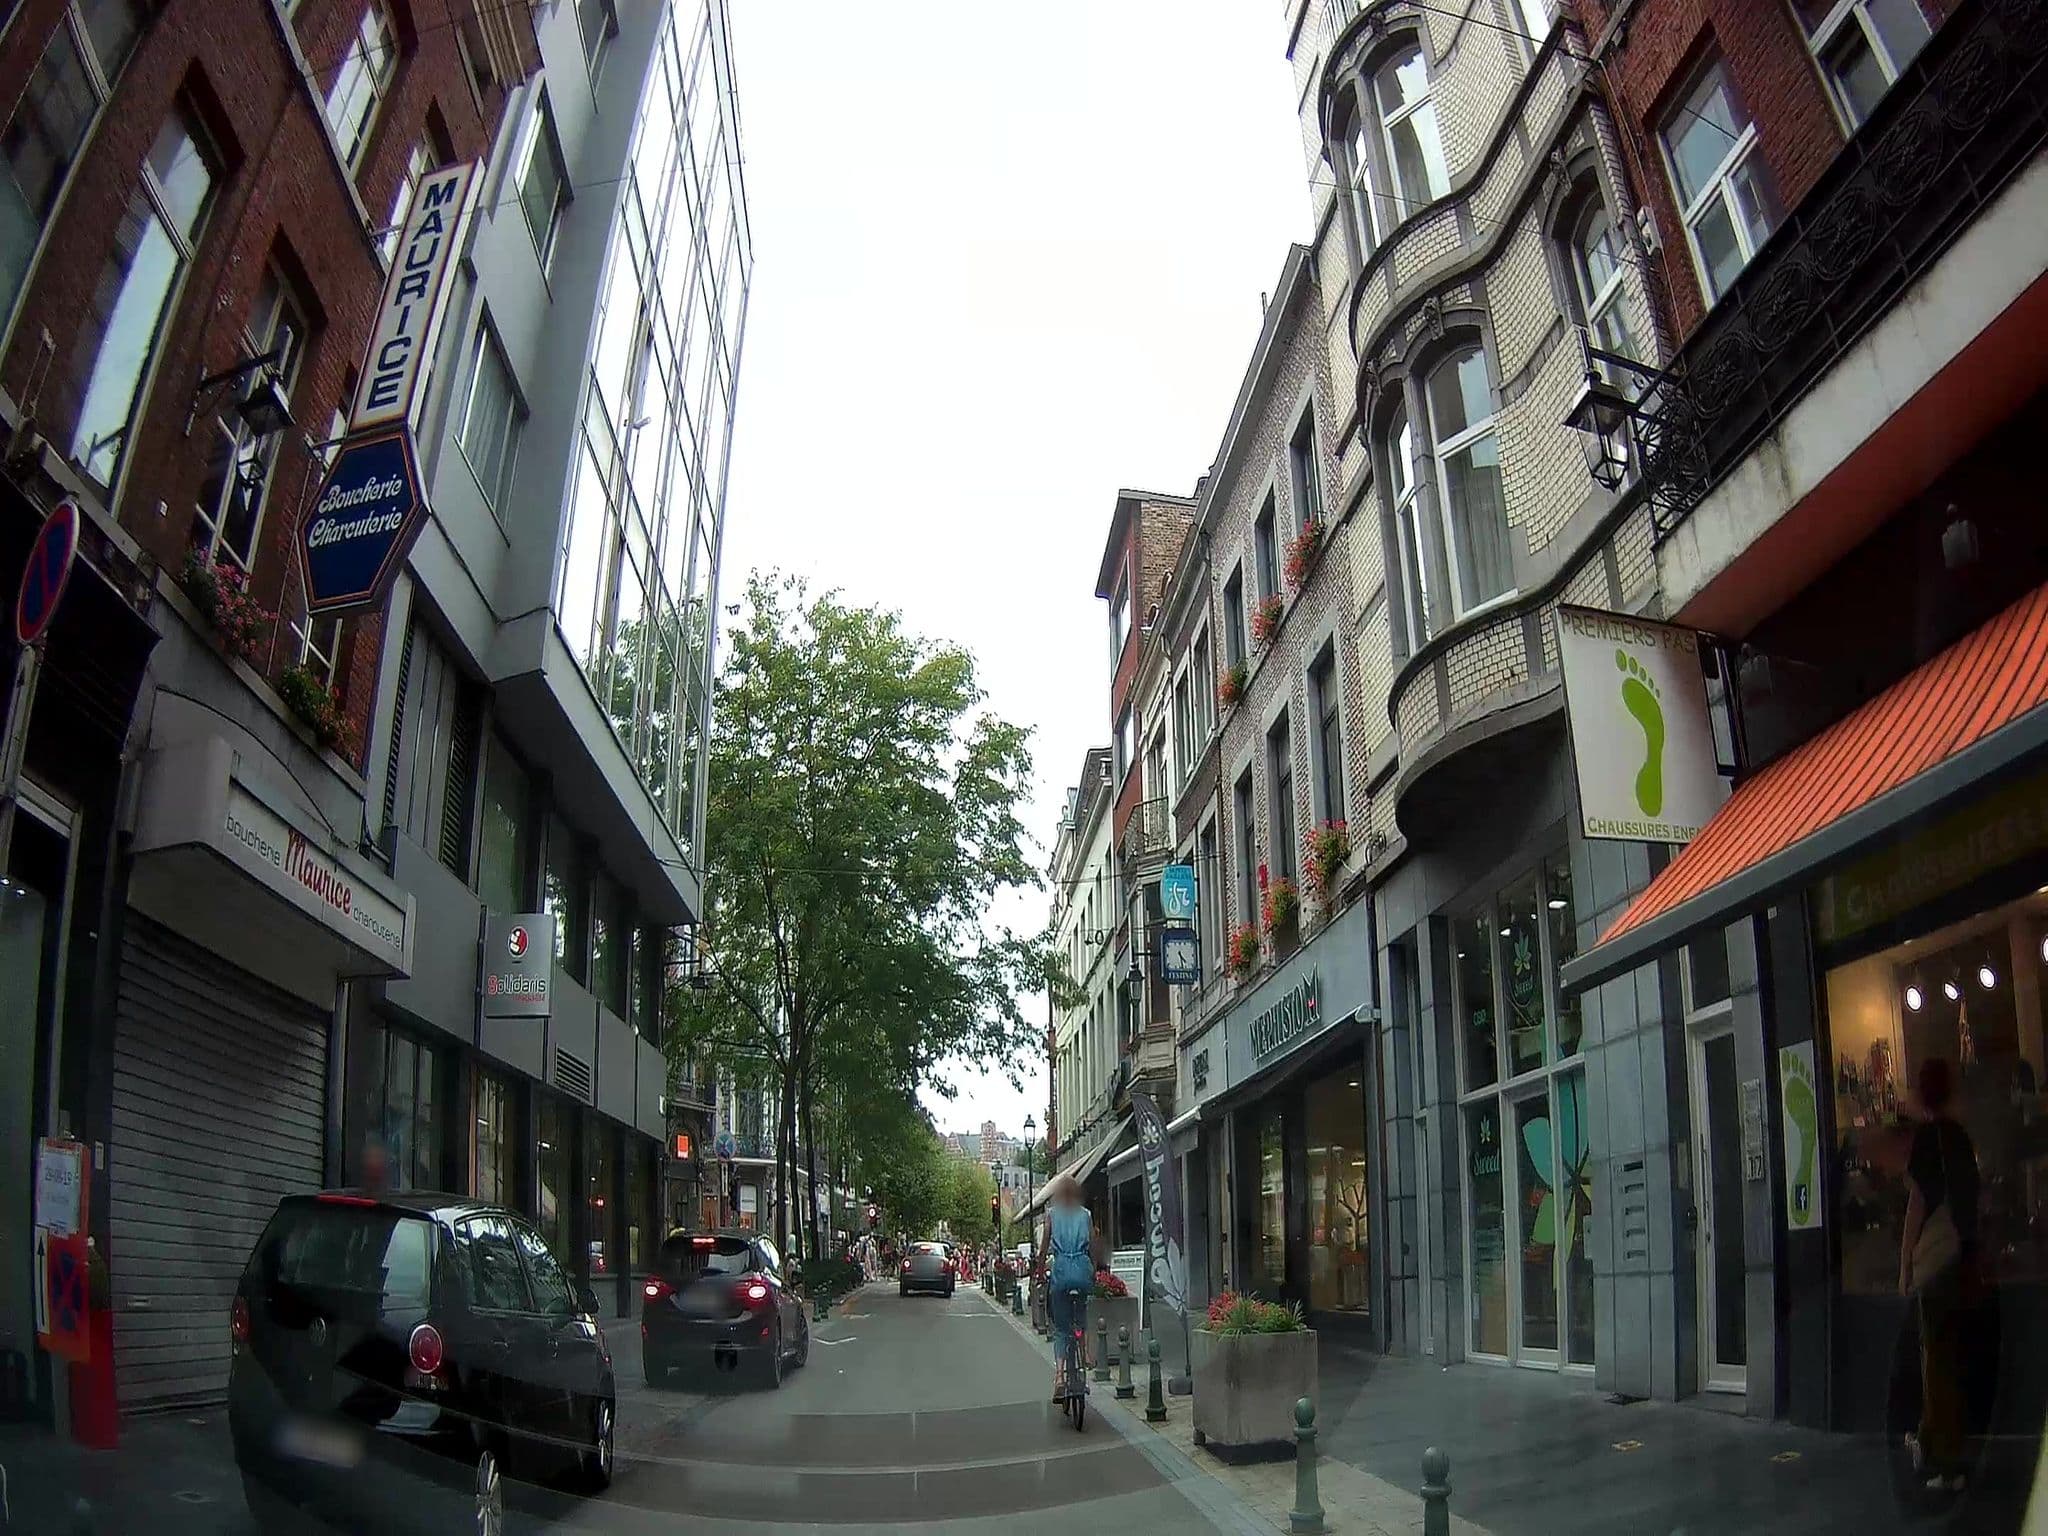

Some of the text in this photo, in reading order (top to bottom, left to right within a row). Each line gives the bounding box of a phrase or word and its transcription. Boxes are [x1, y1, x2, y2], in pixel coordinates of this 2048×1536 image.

[366, 178, 459, 411] MAURICE
[317, 473, 403, 514] Boucherie
[308, 506, 403, 548] Charcuterie
[1559, 613, 1696, 655] PREMIERS PAS
[1587, 816, 1669, 839] CHAUSSURES
[284, 827, 351, 914] Maurice
[488, 974, 546, 994] Solidaris
